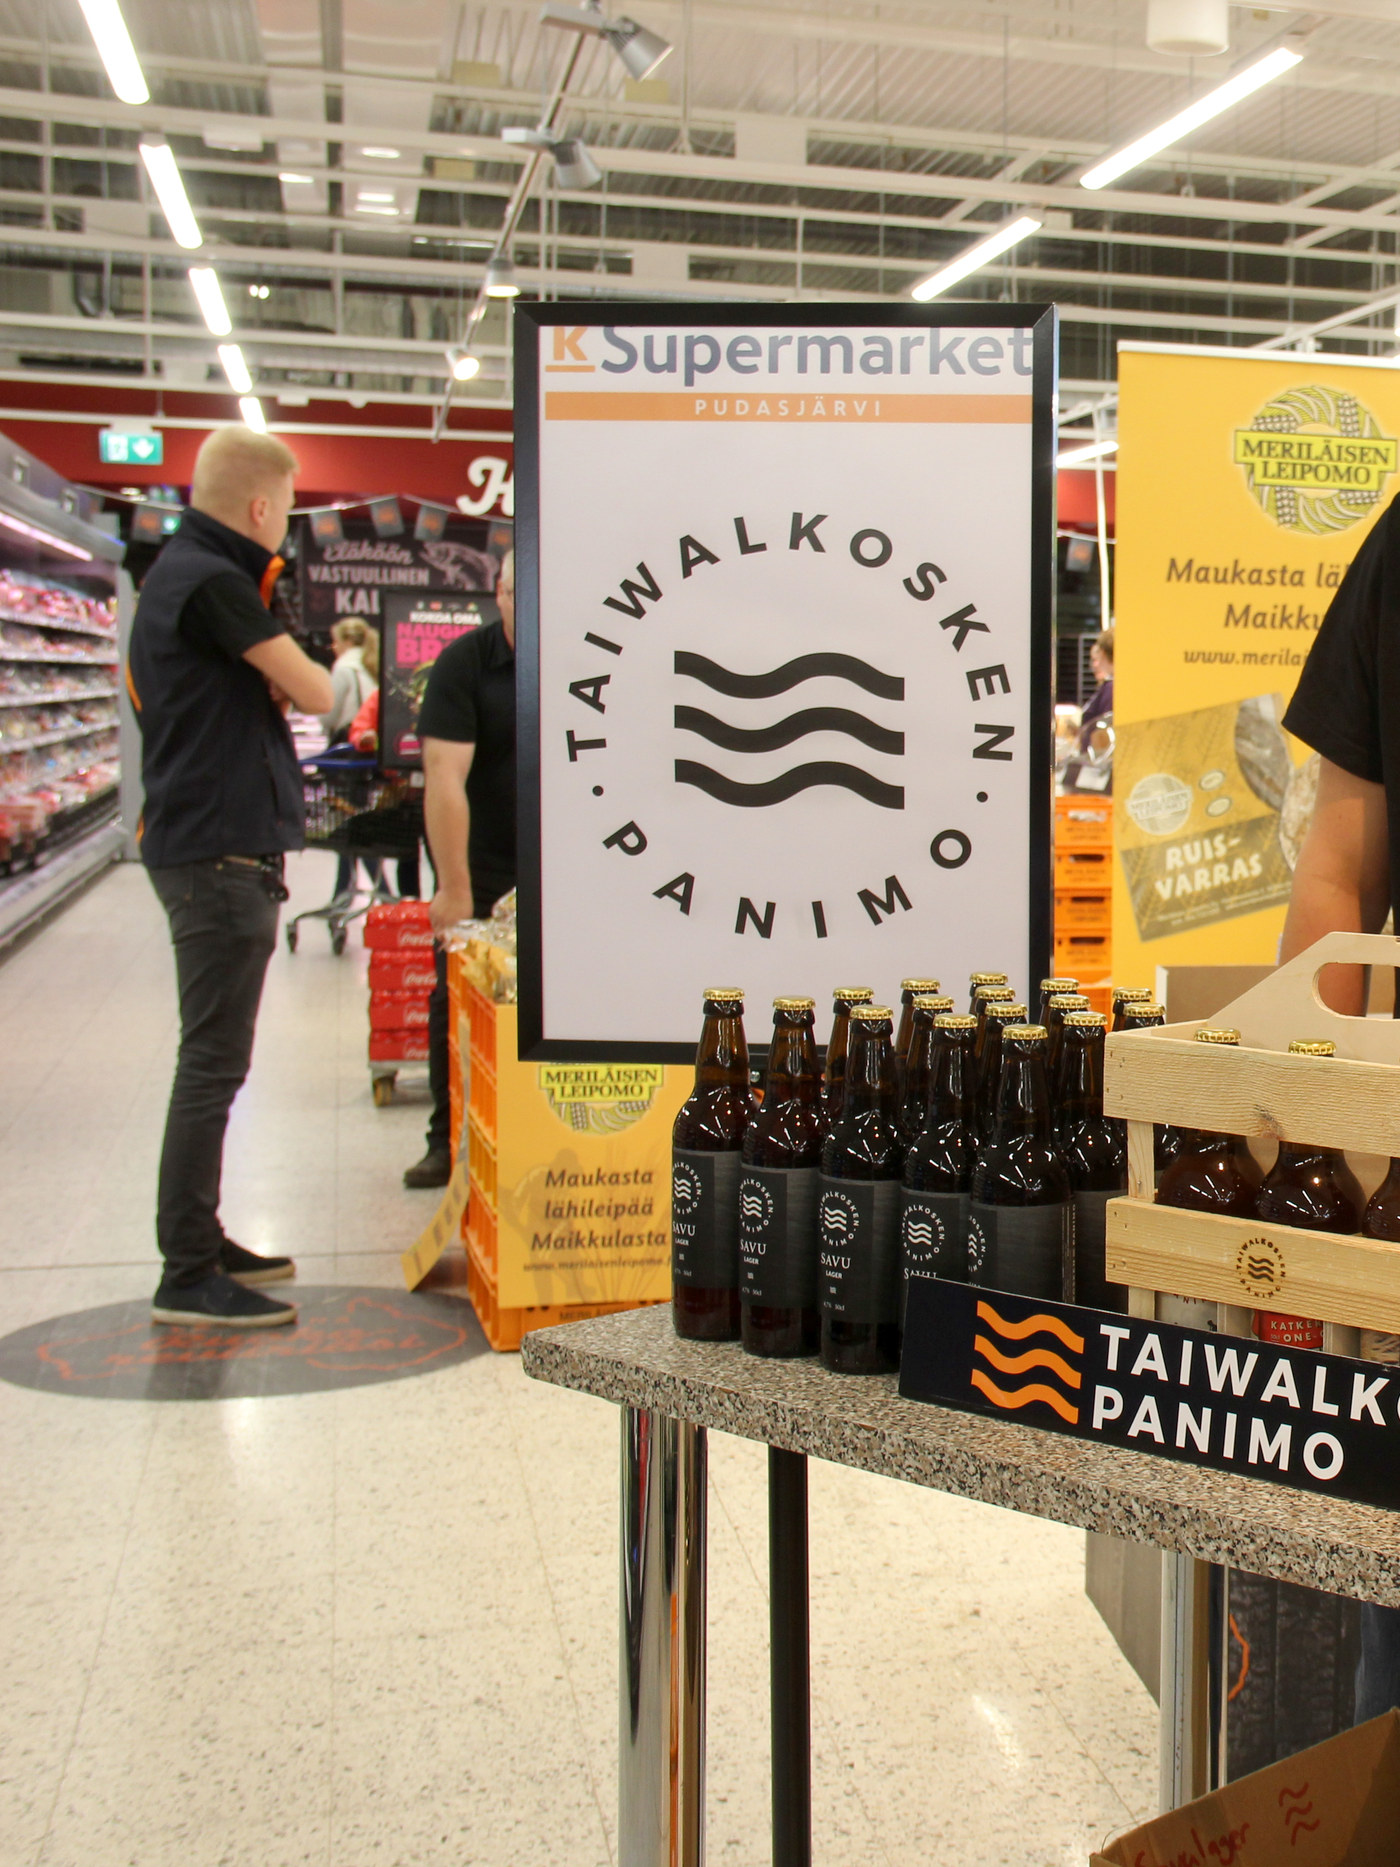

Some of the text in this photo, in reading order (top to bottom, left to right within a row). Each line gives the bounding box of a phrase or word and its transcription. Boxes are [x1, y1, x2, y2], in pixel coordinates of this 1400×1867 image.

[601, 327, 1033, 386] Supermarket
[696, 396, 882, 417] PUDASJÄRVI
[1242, 439, 1391, 465] MERILÄISEN
[1262, 461, 1371, 485] LEIPOMO
[308, 564, 430, 586] VASTUULLINEN
[1166, 558, 1305, 588] Maukasta
[566, 512, 1015, 762] TAIWALKOSKEN
[1165, 833, 1241, 871] RUIS-
[602, 820, 972, 939] PANIMO
[1155, 854, 1263, 900] VARRAS
[545, 1065, 658, 1085] MERILÄISEN
[560, 1084, 644, 1099] LEIPOMO
[545, 1168, 654, 1188] Maukasta
[545, 1199, 654, 1221] lähileipää
[531, 1230, 668, 1251] Maikkulasta
[740, 1238, 767, 1256] SAVU
[820, 1252, 851, 1269] SAVU
[825, 1270, 843, 1280] LAGER
[1271, 1320, 1323, 1331] KATKER
[1092, 1388, 1344, 1481] PANIMO
